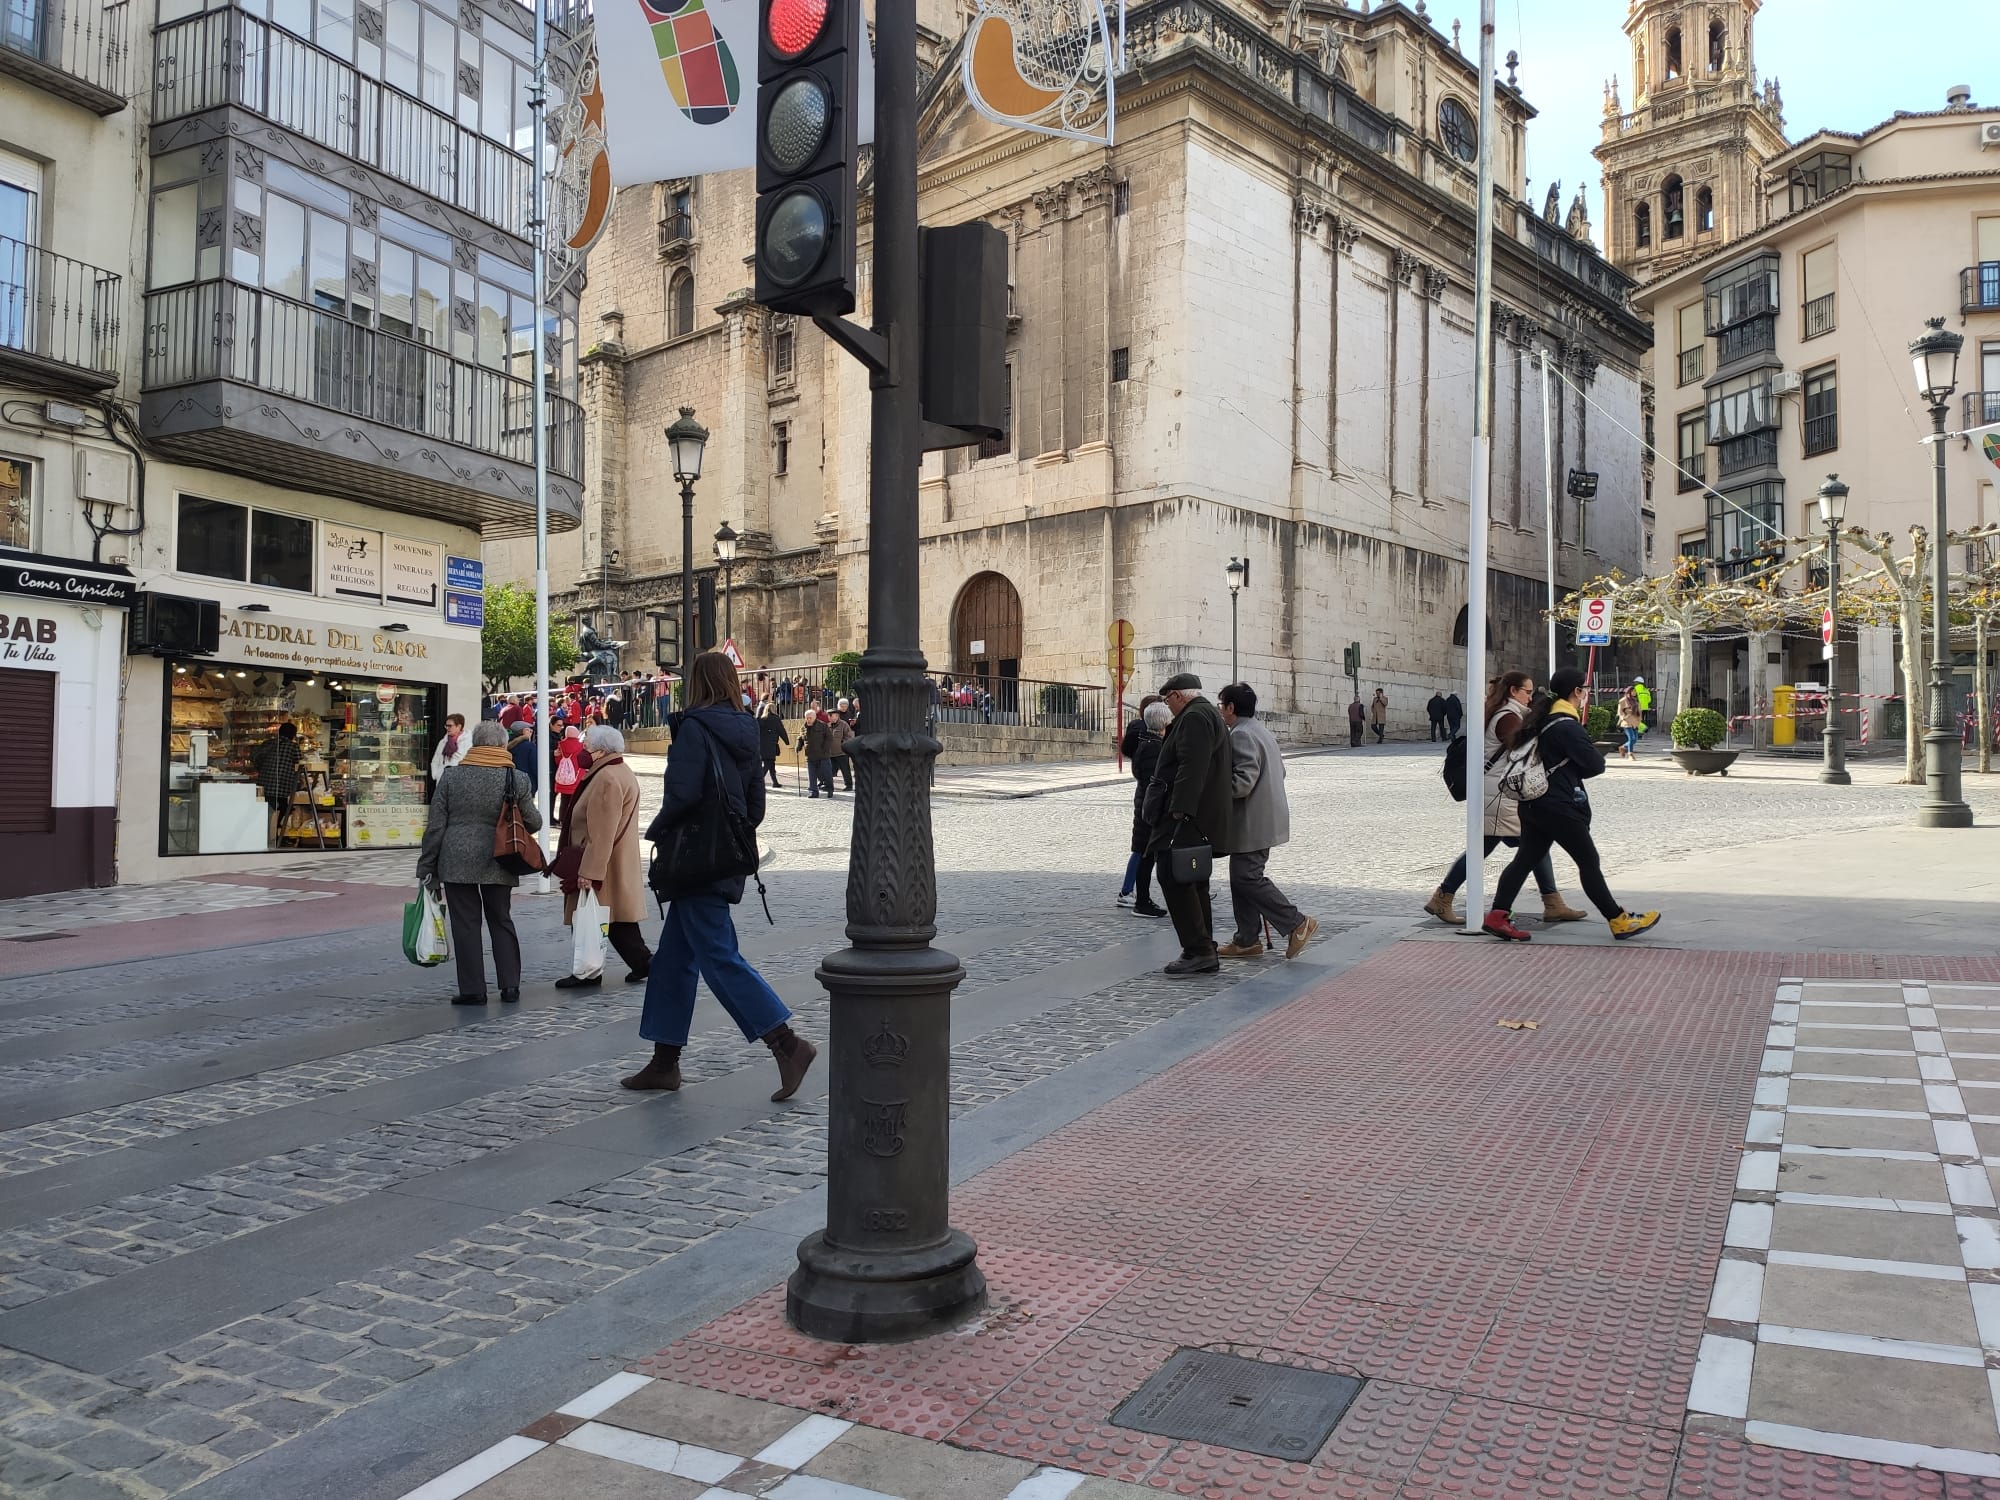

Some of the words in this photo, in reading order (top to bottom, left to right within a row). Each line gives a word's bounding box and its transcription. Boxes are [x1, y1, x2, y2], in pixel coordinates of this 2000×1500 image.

[393, 543, 433, 557] SOUVENIRS
[331, 564, 375, 577] ARTÍCULOS
[393, 562, 433, 577] MINERALES
[462, 562, 474, 570] Calle
[18, 571, 61, 590] Comer
[65, 577, 126, 599] Caprichos
[330, 573, 376, 587] RELIGIOSOS
[397, 583, 429, 595] REGALOS
[0, 613, 57, 643] BAB
[219, 614, 317, 646] CATEDRAL
[327, 628, 364, 652] DEL
[372, 634, 428, 659] SABOR
[3, 642, 20, 660] Tu
[24, 644, 56, 662] Vida
[244, 644, 289, 661] Artesanos
[291, 651, 302, 661] de
[362, 661, 369, 672] y
